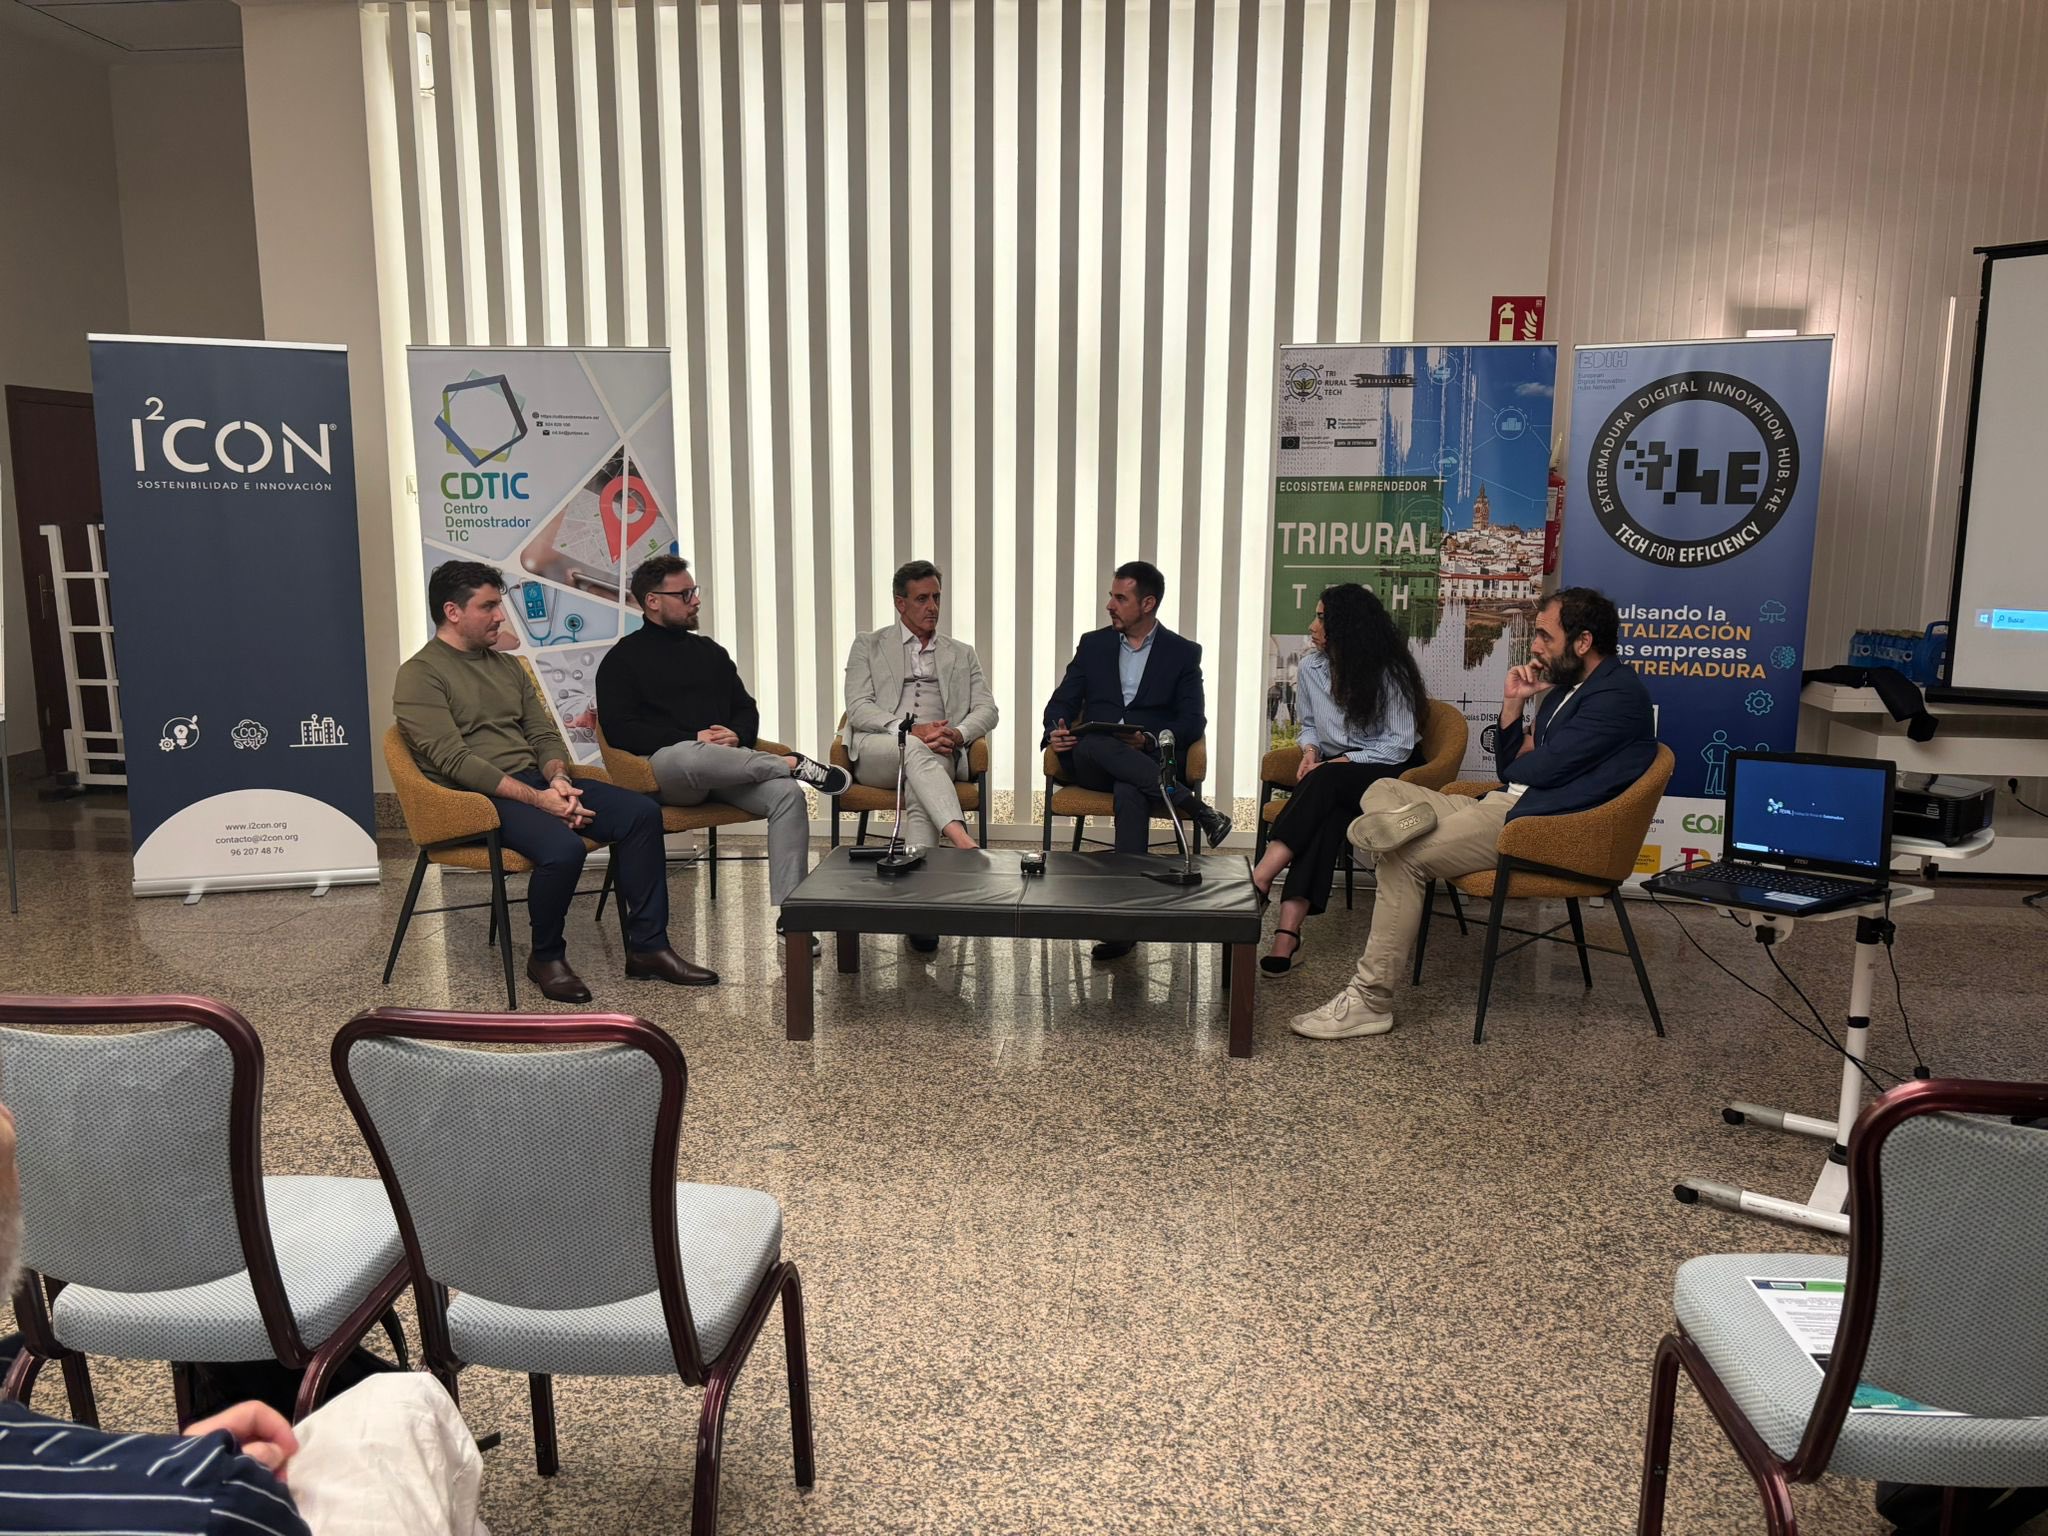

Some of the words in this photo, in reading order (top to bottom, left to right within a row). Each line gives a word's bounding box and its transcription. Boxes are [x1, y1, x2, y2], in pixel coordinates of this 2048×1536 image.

[1578, 350, 1628, 369] EDIH
[1638, 380, 1698, 410] DIGITAL
[1707, 380, 1786, 441] INNOVATION
[1596, 411, 1635, 513] EXTREMADURA
[1777, 447, 1791, 482] HUB.
[137, 480, 238, 490] SOSTENIBILIDAD
[244, 481, 250, 490] E
[255, 481, 332, 491] INNOVACIÓN
[441, 472, 530, 500] CDTIC
[1279, 481, 1345, 492] ECOSISTEMA
[1348, 480, 1428, 492] EMPRENDEDOR
[443, 502, 488, 514] Centro
[1764, 487, 1786, 513] T4E
[445, 515, 531, 528] Demostrador
[446, 529, 469, 541] TIC
[1277, 522, 1437, 556] TRIRURAL
[1615, 523, 1650, 554] TECH
[1649, 542, 1676, 561] FOR
[1679, 521, 1761, 563] EFFICIENCY
[1292, 583, 1409, 611] TH
[1617, 604, 1702, 621] ulsando
[1707, 605, 1727, 622] la
[1619, 621, 1751, 641] TALIZACIÓN
[1616, 644, 1635, 656] as
[1640, 644, 1747, 661] empresas
[1622, 660, 1767, 679] TREMADURA
[225, 821, 288, 831] www.i2con.org
[215, 833, 299, 845] contacto@i2con.org
[230, 848, 242, 856] 96
[243, 847, 259, 856] 207
[260, 846, 271, 855] 48
[273, 845, 285, 854] 76
